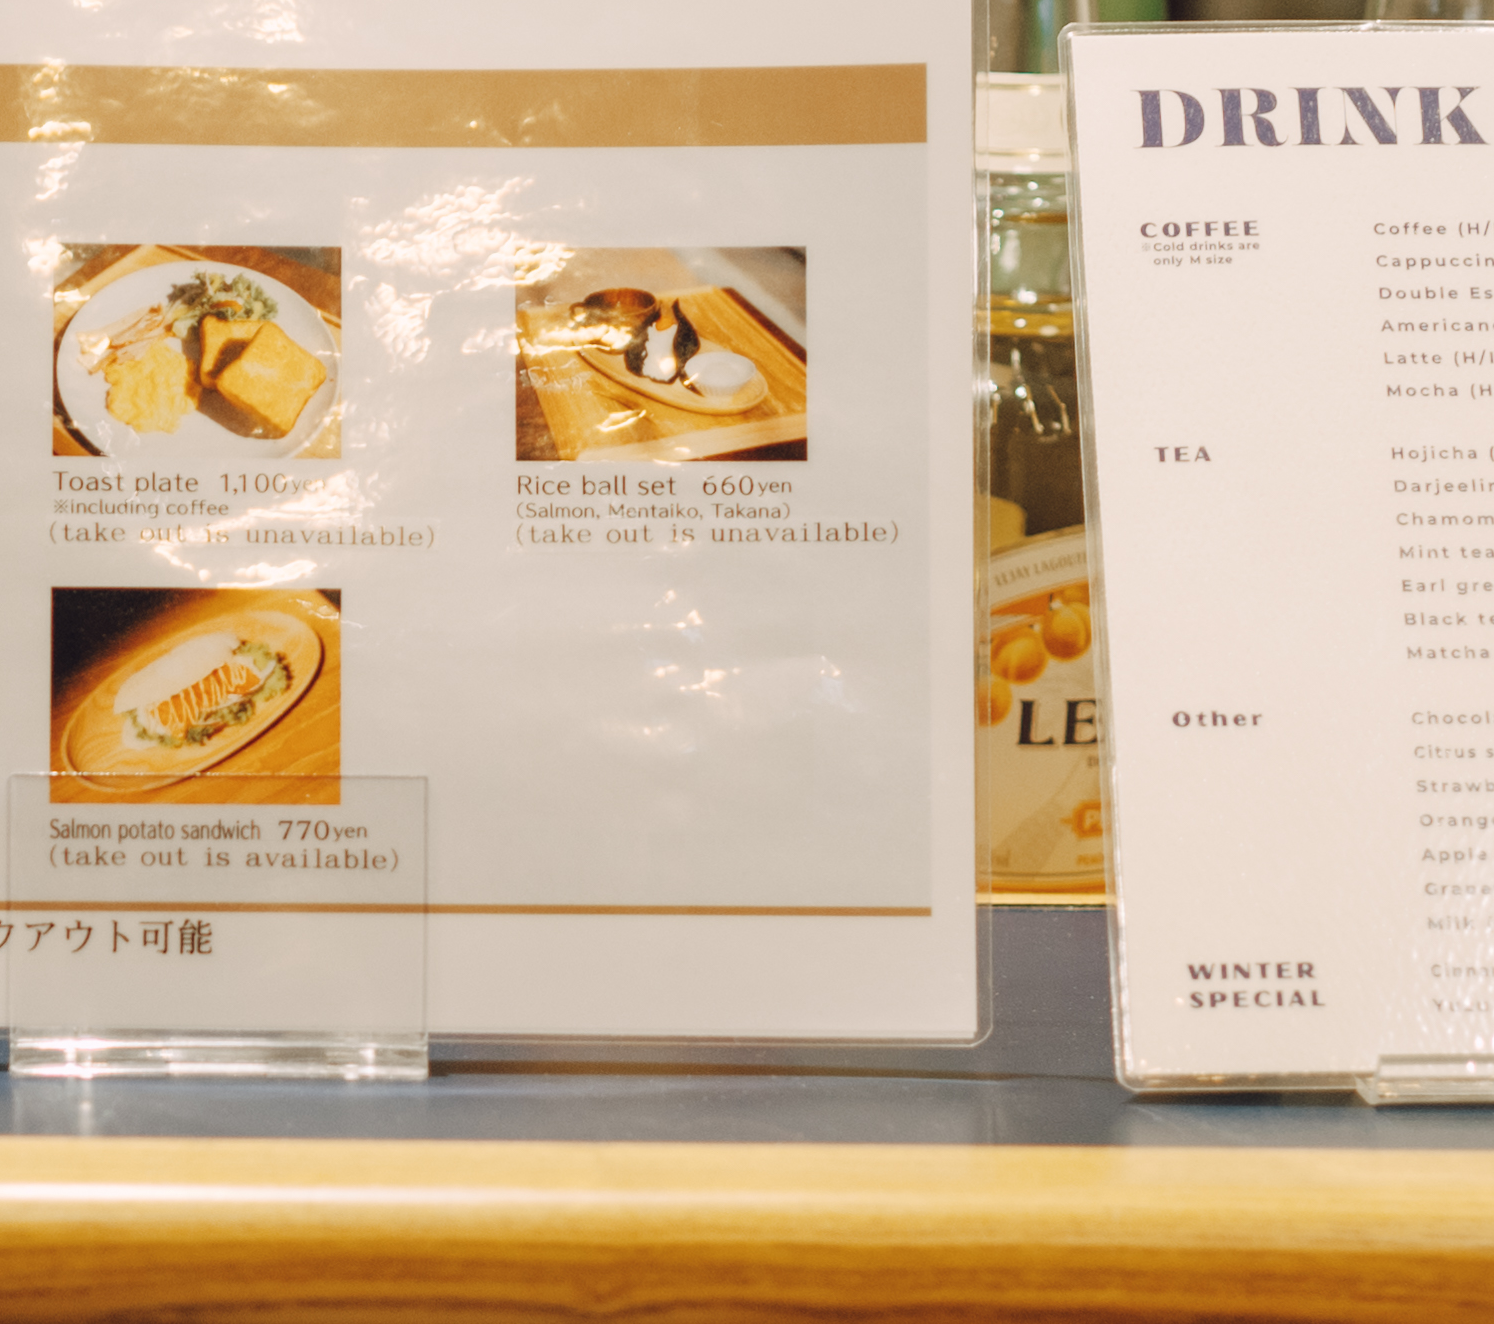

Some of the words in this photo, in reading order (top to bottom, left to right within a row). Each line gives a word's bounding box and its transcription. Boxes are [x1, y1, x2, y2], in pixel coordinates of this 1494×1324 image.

[1133, 85, 1489, 150] DRINK
[1138, 219, 1260, 240] COFFEE
[1372, 220, 1447, 236] Coffee
[1378, 285, 1459, 300] Double
[1154, 445, 1212, 464] TEA
[517, 474, 571, 497] Rice
[581, 474, 627, 497] ball
[637, 476, 676, 497] set
[164, 498, 233, 521] coffee
[516, 501, 601, 520] (Salmon,
[608, 502, 703, 520] Mentaiko,
[712, 501, 791, 520] Takana)
[1171, 710, 1260, 728] Other
[49, 818, 112, 841] Salmon
[117, 821, 175, 844] potato
[180, 819, 261, 842] sandwich
[1188, 961, 1314, 981] WINTER
[1189, 989, 1326, 1011] SPECIAL
